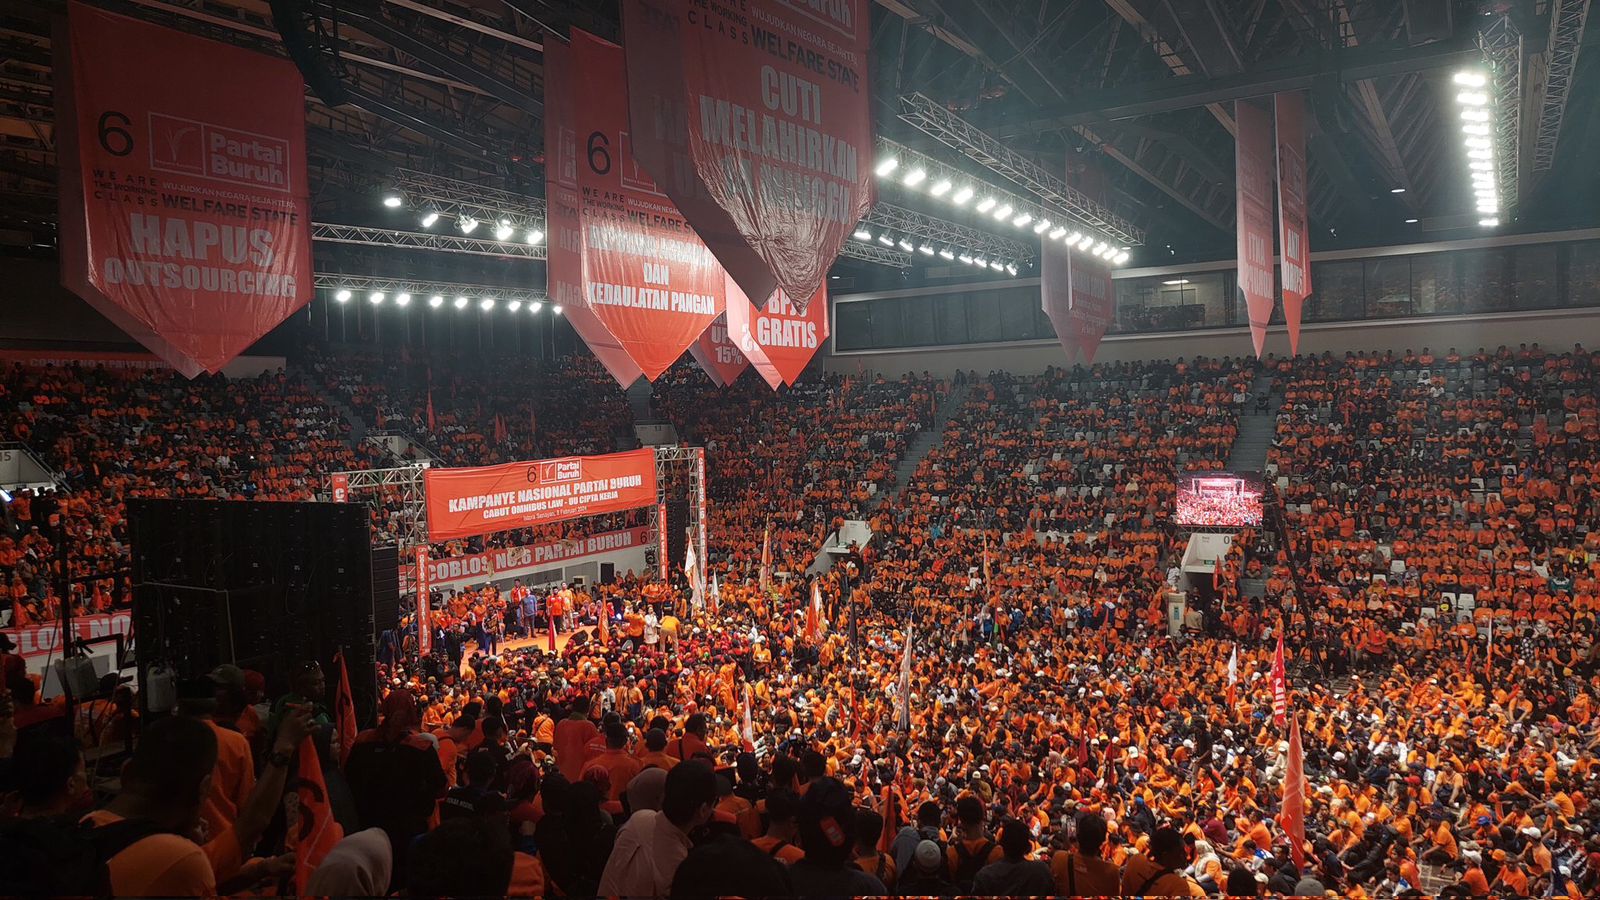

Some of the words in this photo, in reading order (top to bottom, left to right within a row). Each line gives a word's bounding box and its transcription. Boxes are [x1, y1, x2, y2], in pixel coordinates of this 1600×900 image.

[688, 12, 748, 45] CLASS
[707, 3, 747, 27] WORKING
[751, 6, 796, 37] WUJUDKAN
[796, 26, 827, 49] NEGARA
[751, 26, 825, 76] WELFARE
[828, 57, 860, 93] STATE
[760, 64, 822, 125] CUTI
[97, 110, 134, 157] 6
[210, 132, 283, 165] Partai
[699, 94, 858, 184] MELAHIRKAN
[211, 152, 285, 185] Buruh
[587, 131, 611, 175] 6
[93, 169, 117, 181] WE
[126, 174, 157, 187] ARE
[162, 181, 215, 198] WUJUDKAN
[216, 189, 250, 202] NEGARA
[94, 191, 158, 207] CLASS
[161, 193, 248, 218] WELFARE
[251, 206, 299, 226] STATE
[582, 187, 598, 197] WE
[604, 190, 625, 203] ARE
[583, 198, 596, 207] THE
[597, 201, 625, 212] WORKING
[627, 198, 662, 212] WUJUDKAN
[583, 207, 626, 223] CLASS
[627, 209, 682, 232] WELFARE
[129, 212, 274, 269] HAPUS
[103, 256, 297, 298] OUTSOURCING
[643, 262, 669, 286] DAN
[589, 281, 669, 312] KEDAULATAN
[671, 291, 715, 315] PANGAN
[757, 316, 818, 349] GRATIS
[715, 346, 743, 366] 15%
[527, 465, 537, 483] 6
[557, 460, 580, 471] Partai
[557, 469, 580, 480] Buruh
[449, 490, 516, 513] KAMPANYE
[518, 484, 572, 503] NASIONAL
[573, 479, 608, 495] PARTAI
[610, 475, 642, 489] BURUH
[483, 506, 510, 519] CABUT
[511, 501, 547, 515] OMNIBUS
[548, 498, 564, 509] LAW
[568, 497, 579, 506] UU
[579, 493, 599, 504] CIPTA
[599, 490, 619, 500] KERJA
[427, 557, 488, 582] COBLOS
[535, 542, 585, 562] PARTAI
[586, 533, 632, 551] BURUH
[640, 532, 649, 545] 6
